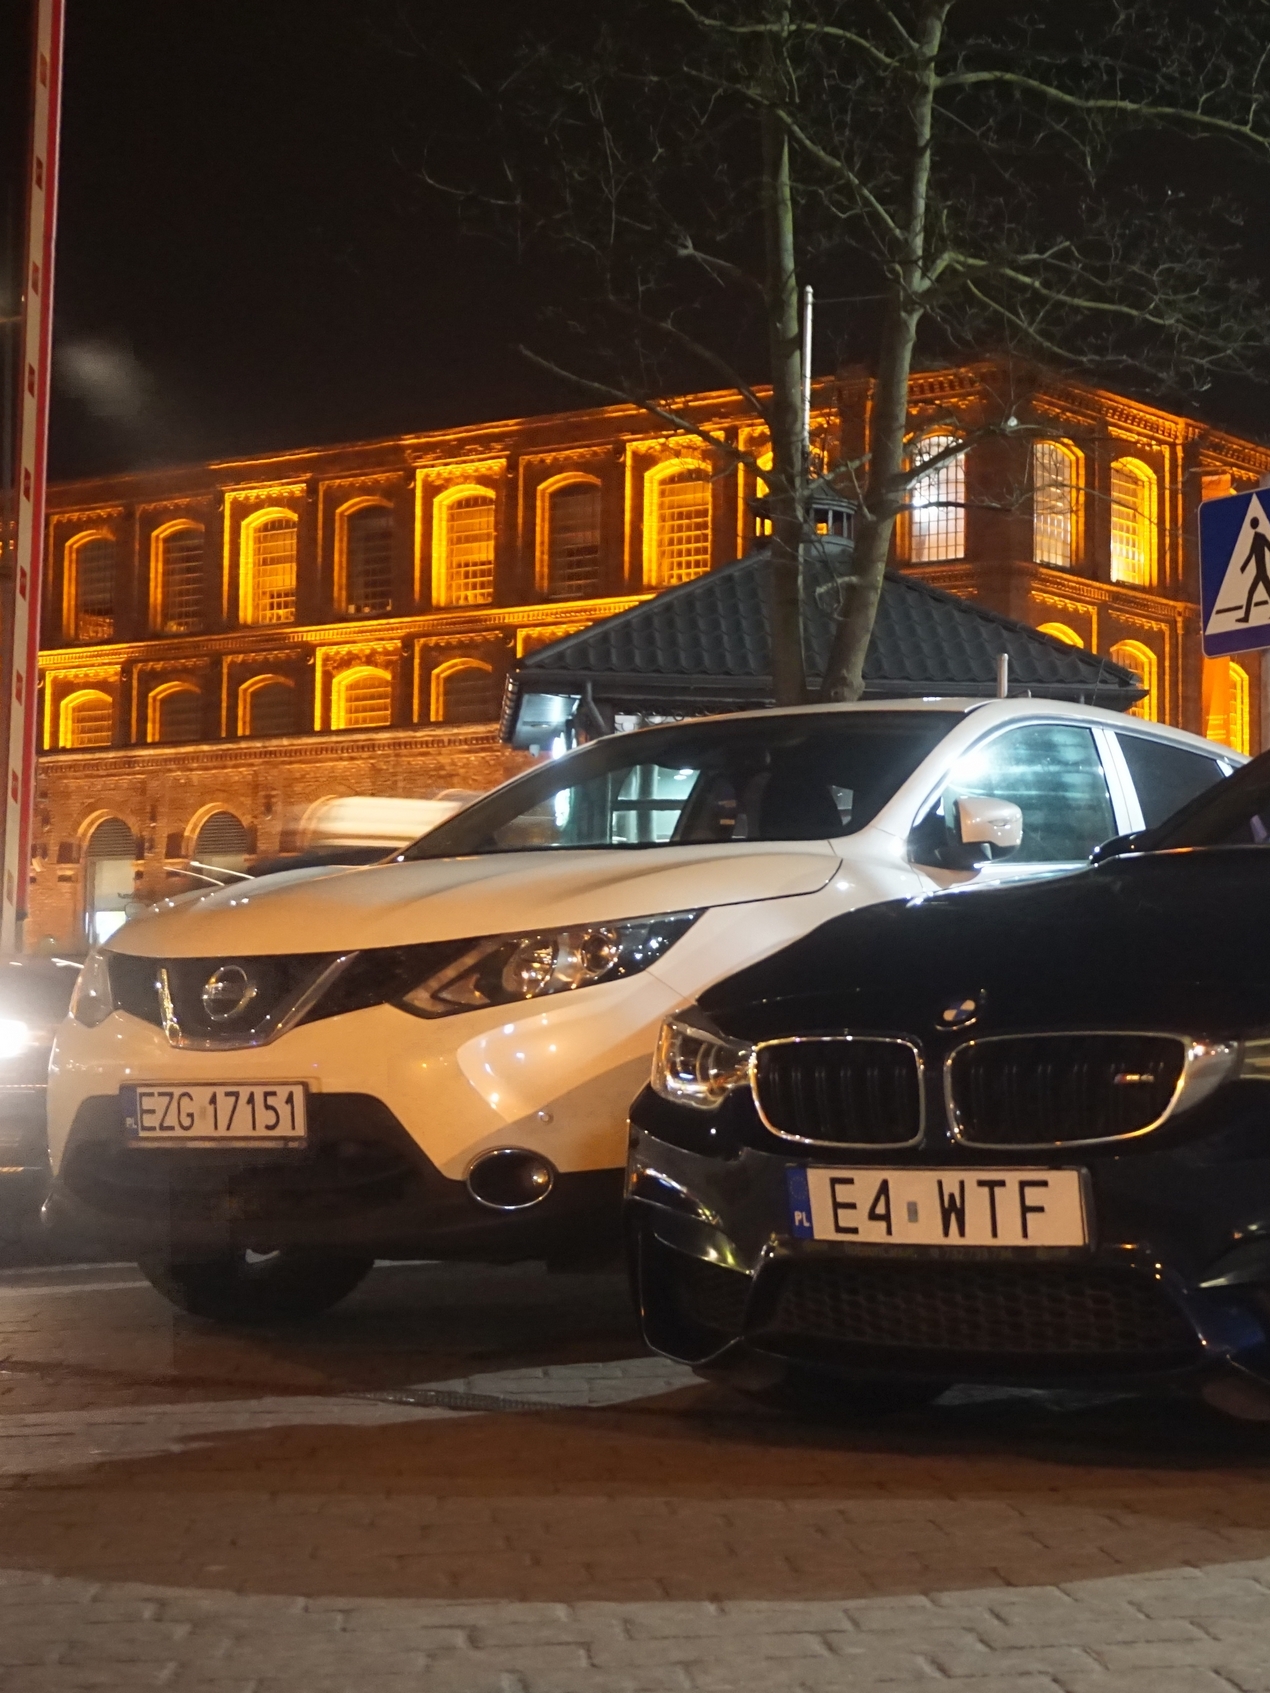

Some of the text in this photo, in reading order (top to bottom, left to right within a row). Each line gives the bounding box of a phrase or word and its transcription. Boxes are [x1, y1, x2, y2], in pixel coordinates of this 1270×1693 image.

[139, 1090, 296, 1132] EZG 17151
[794, 1211, 811, 1227] PL
[829, 1176, 1049, 1239] E4 WTF
